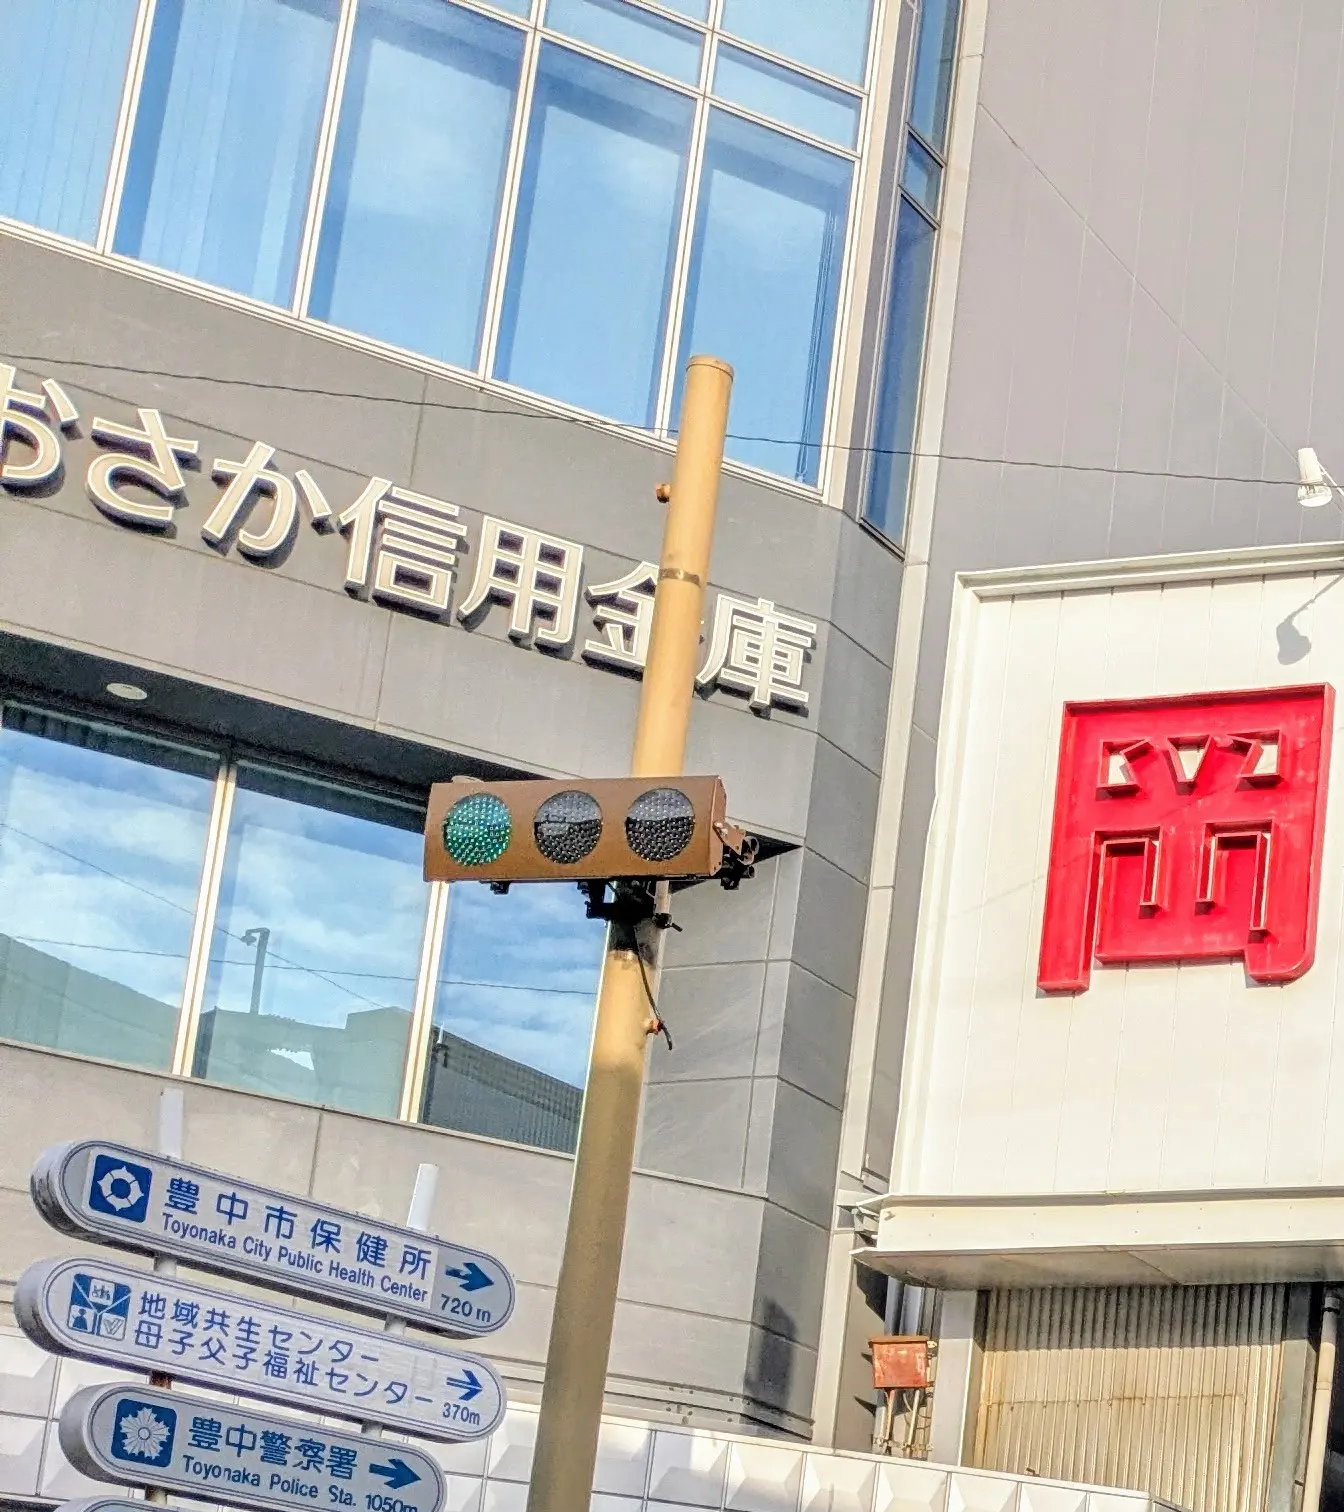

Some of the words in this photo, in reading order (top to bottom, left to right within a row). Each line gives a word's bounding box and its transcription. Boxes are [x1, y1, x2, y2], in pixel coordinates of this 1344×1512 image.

[161, 1213, 237, 1250] Toyonaka
[243, 1236, 271, 1262] City
[278, 1247, 324, 1275] Public
[328, 1261, 376, 1290] Health
[380, 1275, 428, 1303] Center
[164, 1177, 433, 1281] 豊中市保健所
[134, 1319, 435, 1406] 母子父子福祉センター
[137, 1291, 381, 1363] 地域共生センター
[187, 1415, 359, 1482] 豊中警察署
[442, 1401, 481, 1427] 370m
[182, 1455, 261, 1489] Toyonaka
[269, 1472, 320, 1501] Police
[328, 1485, 357, 1508] Sta.
